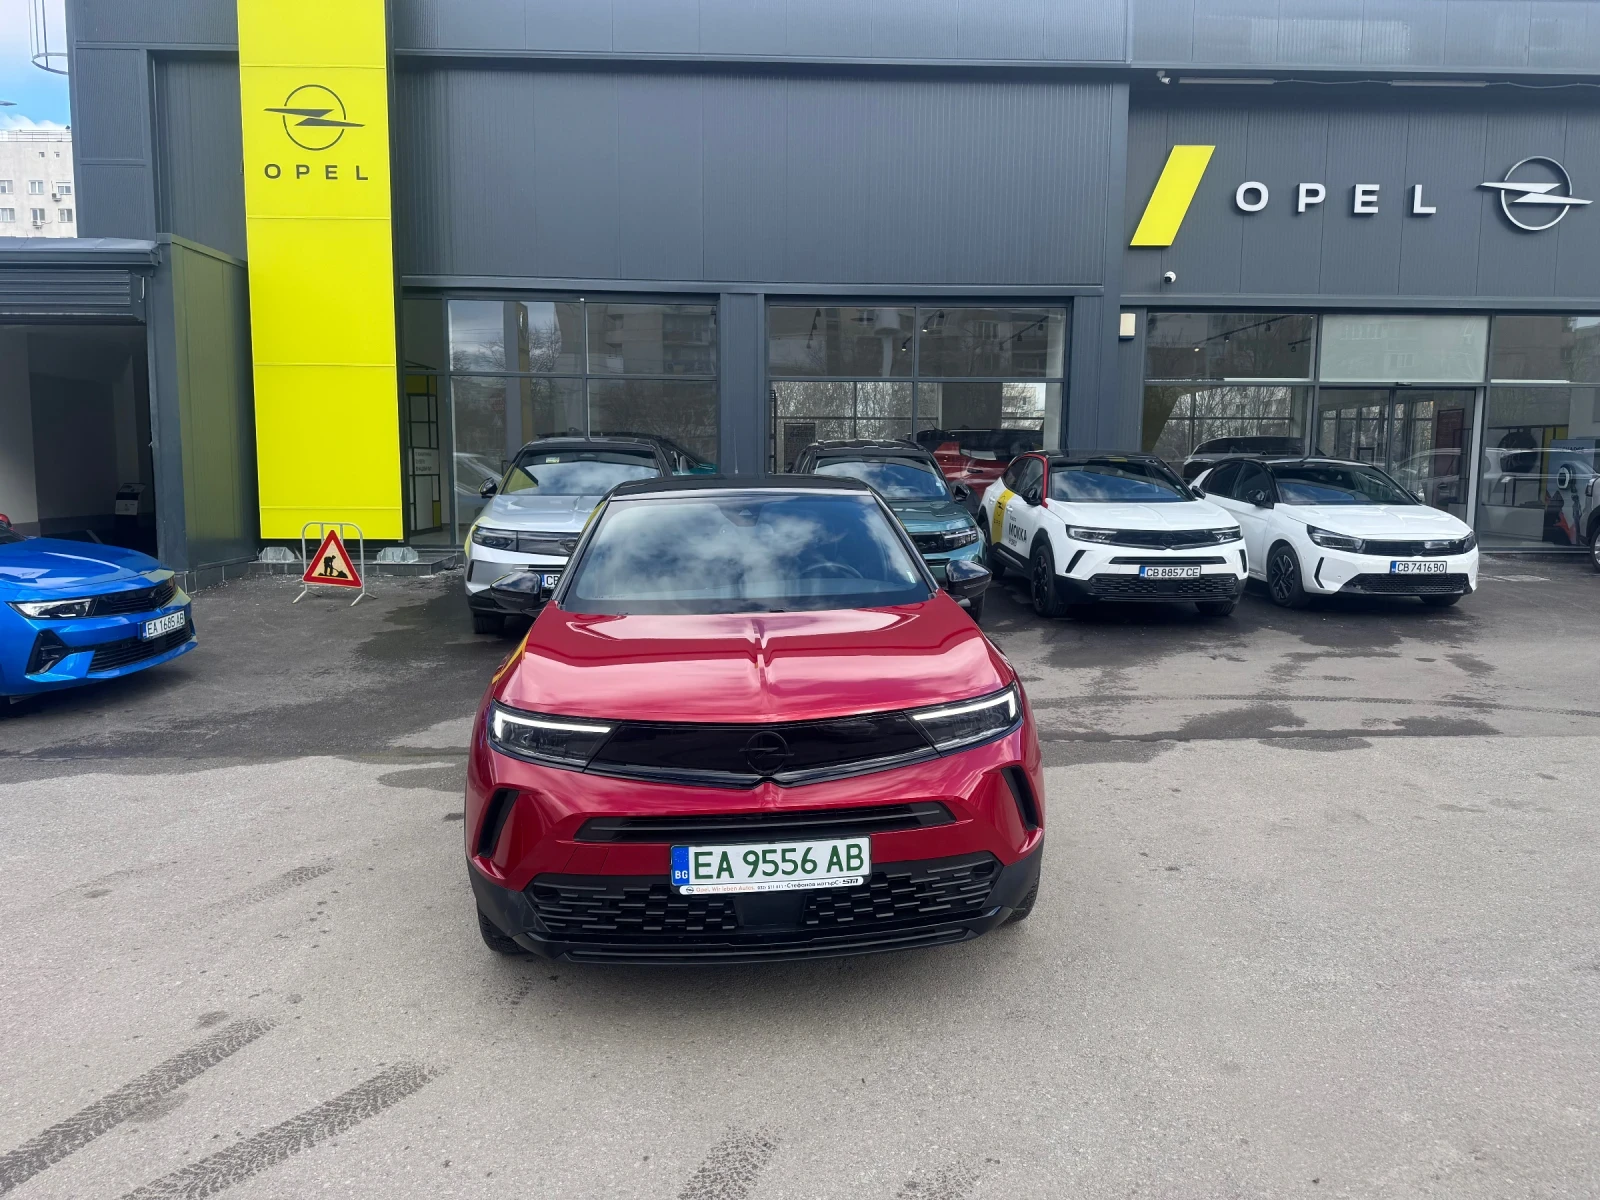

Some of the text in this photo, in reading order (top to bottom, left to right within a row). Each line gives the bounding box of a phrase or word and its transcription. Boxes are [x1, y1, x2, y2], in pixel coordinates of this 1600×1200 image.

[264, 163, 369, 181] OPEL
[1235, 181, 1437, 214] OPEL
[1009, 523, 1027, 542] MOKKA
[1146, 567, 1199, 577] CB 8857 CE
[1397, 562, 1410, 572] CB
[1410, 562, 1432, 573] 7416
[148, 622, 158, 635] EA
[177, 613, 184, 626] AB
[694, 843, 864, 879] EA 9556 AB
[675, 870, 689, 879] BG
